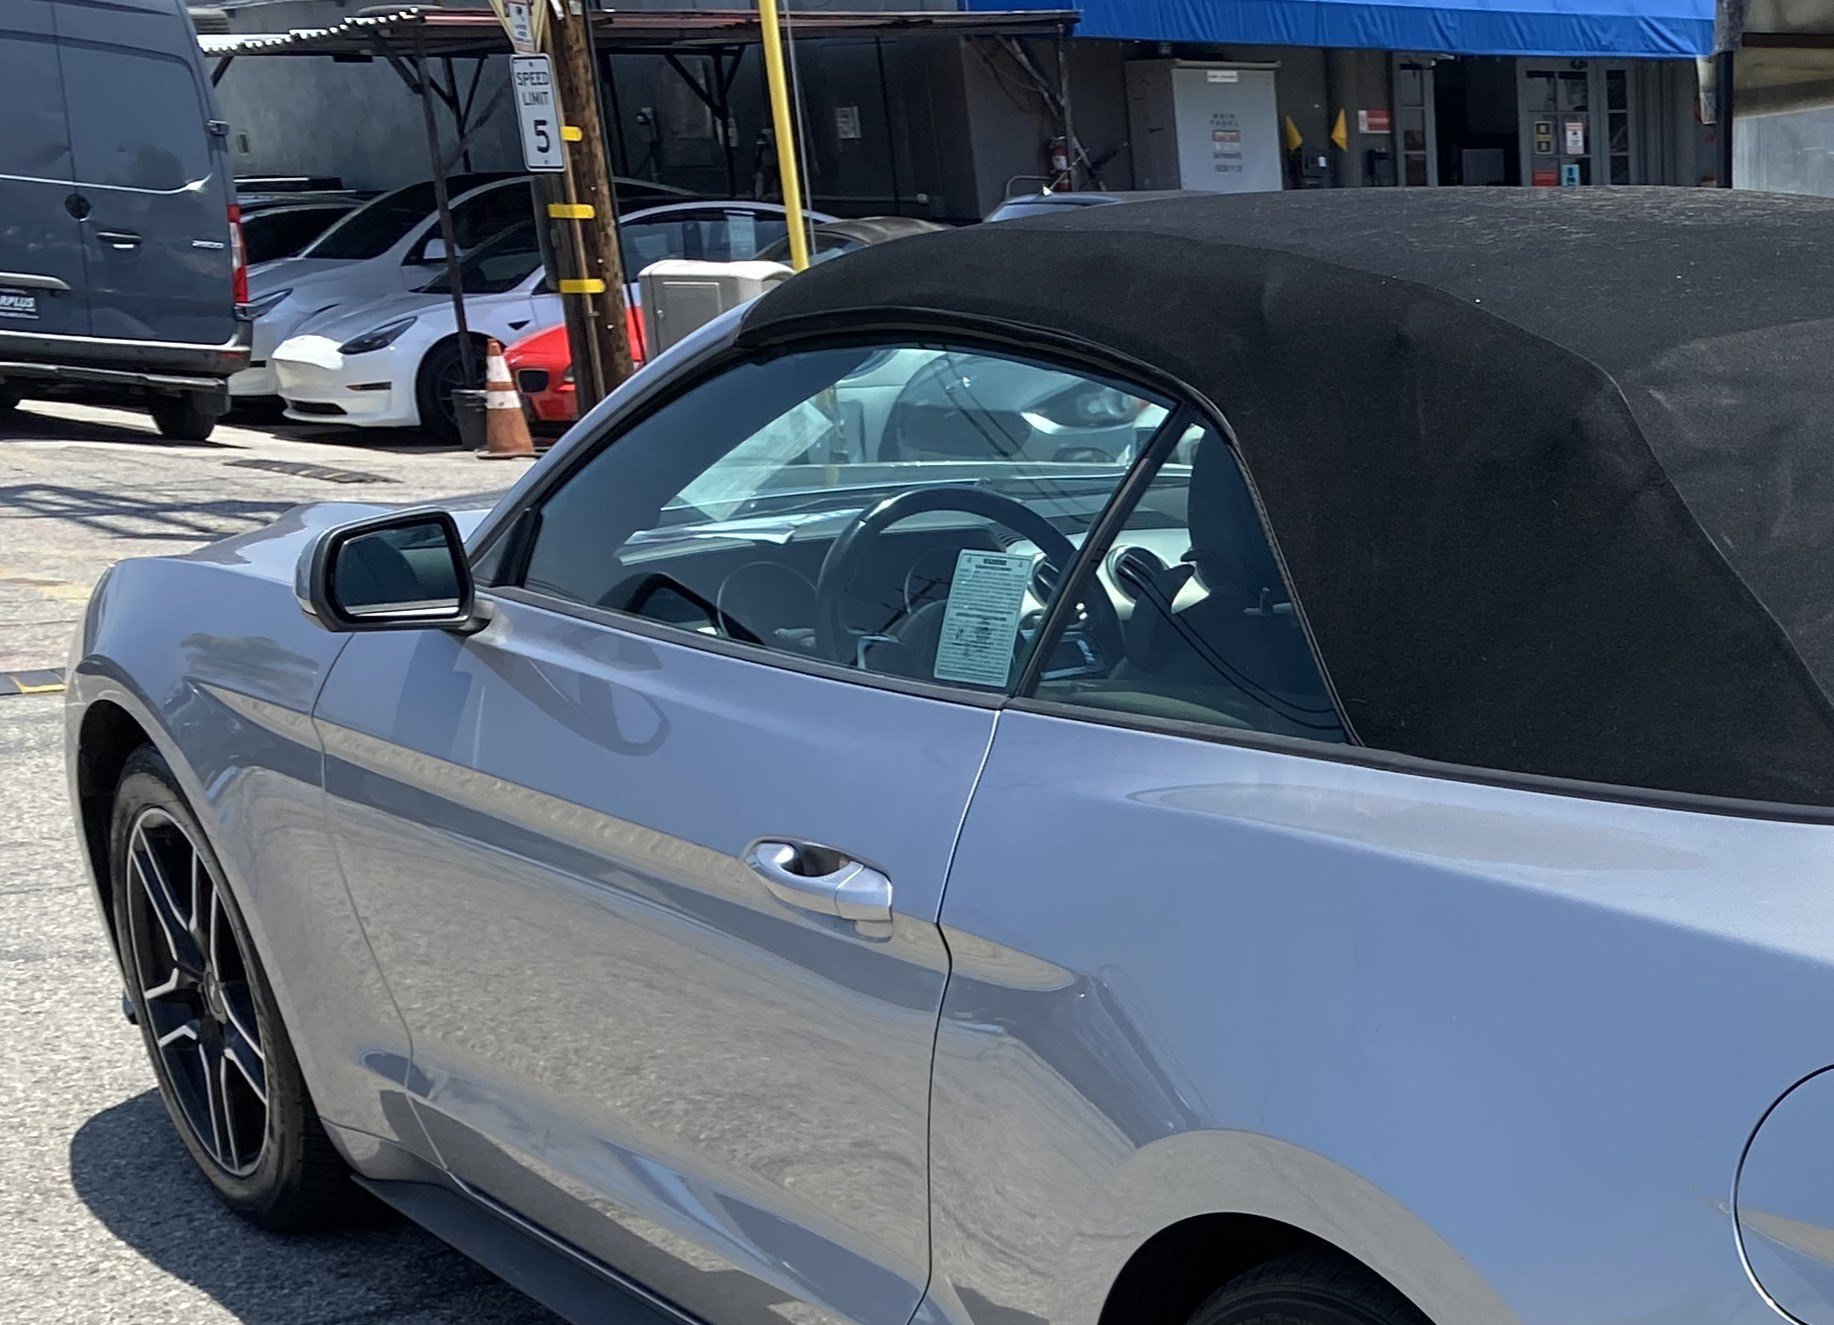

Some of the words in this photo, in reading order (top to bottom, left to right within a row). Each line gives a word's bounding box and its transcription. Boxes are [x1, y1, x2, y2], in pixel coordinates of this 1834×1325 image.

[516, 71, 549, 86] SPEED
[521, 91, 549, 106] LIMIT
[533, 119, 551, 154] 5
